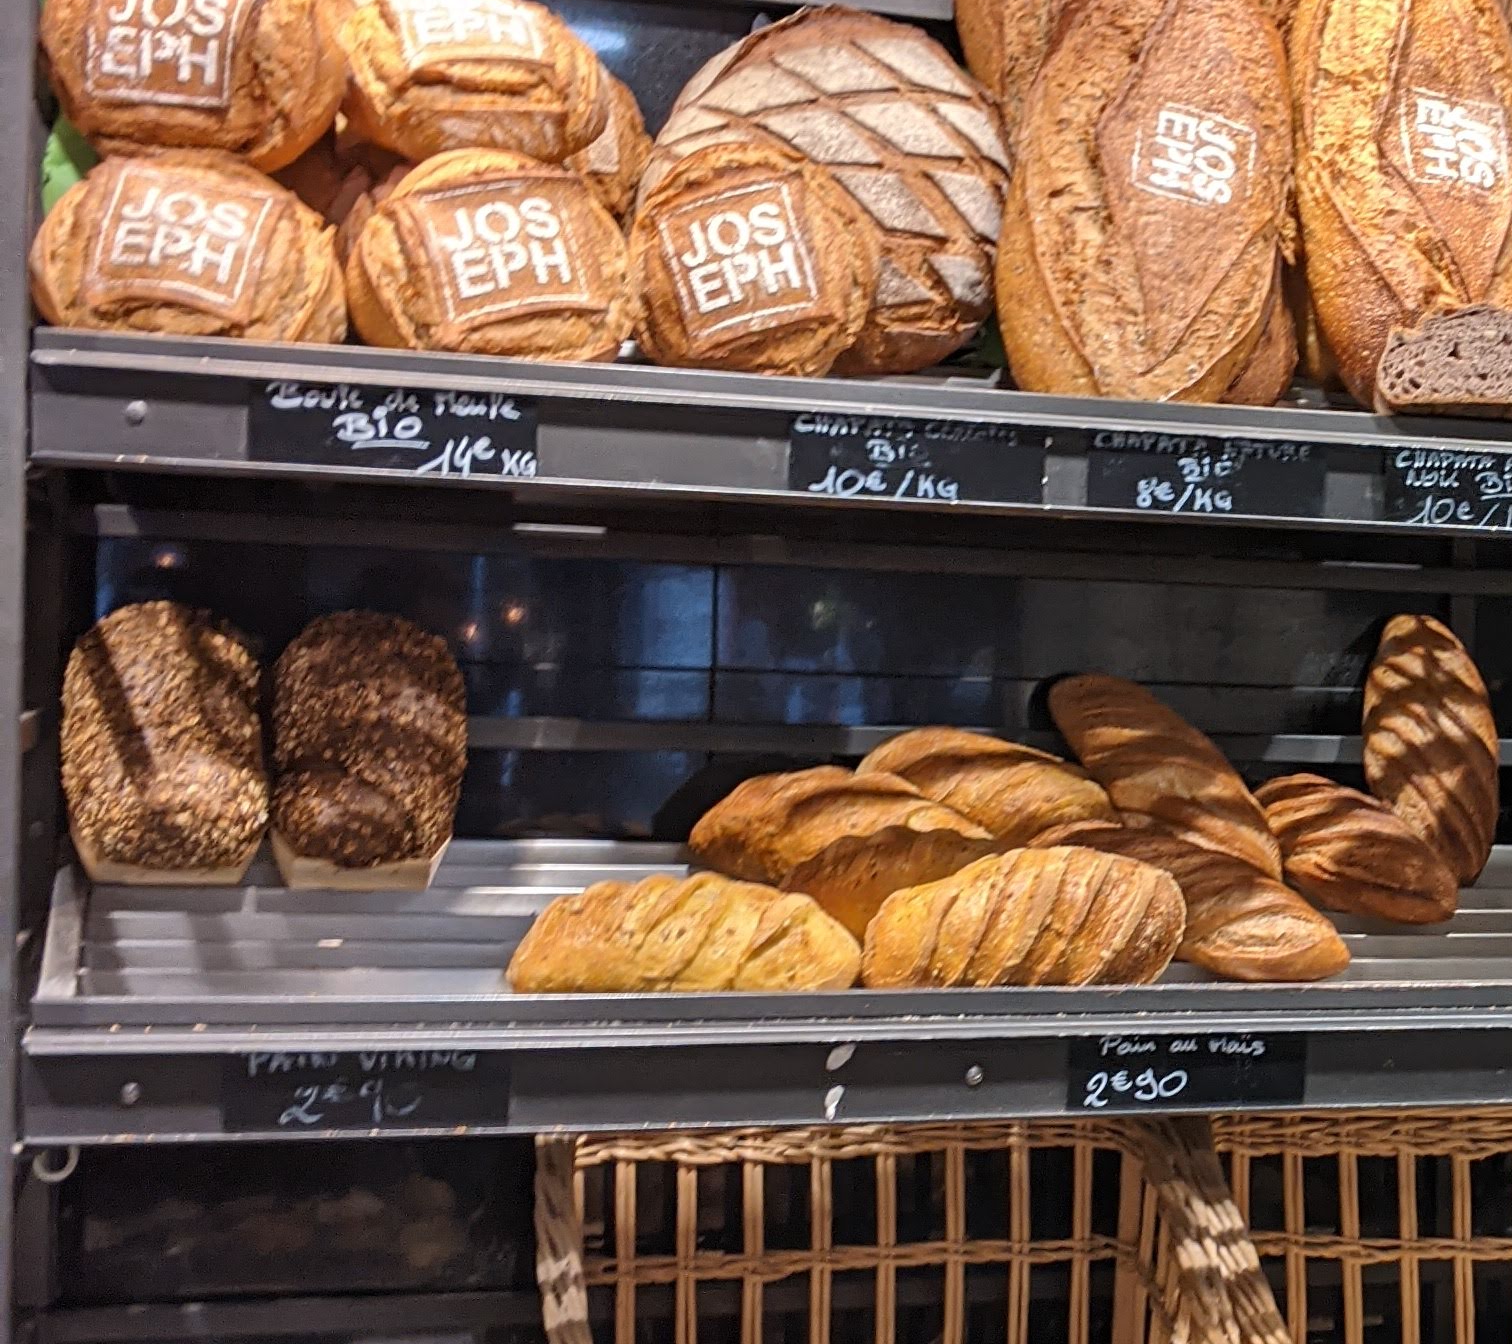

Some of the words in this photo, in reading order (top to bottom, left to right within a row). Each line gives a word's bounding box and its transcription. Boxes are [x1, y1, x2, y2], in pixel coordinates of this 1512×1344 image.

[101, 25, 219, 85] EPH
[122, 187, 248, 238] JOS
[437, 197, 560, 252] JOS
[682, 202, 786, 267] JOS
[110, 220, 237, 285] EPH
[452, 237, 572, 298] EPH
[689, 242, 801, 313] EPH
[1100, 1034, 1157, 1056] Pain
[1168, 1038, 1199, 1054] au
